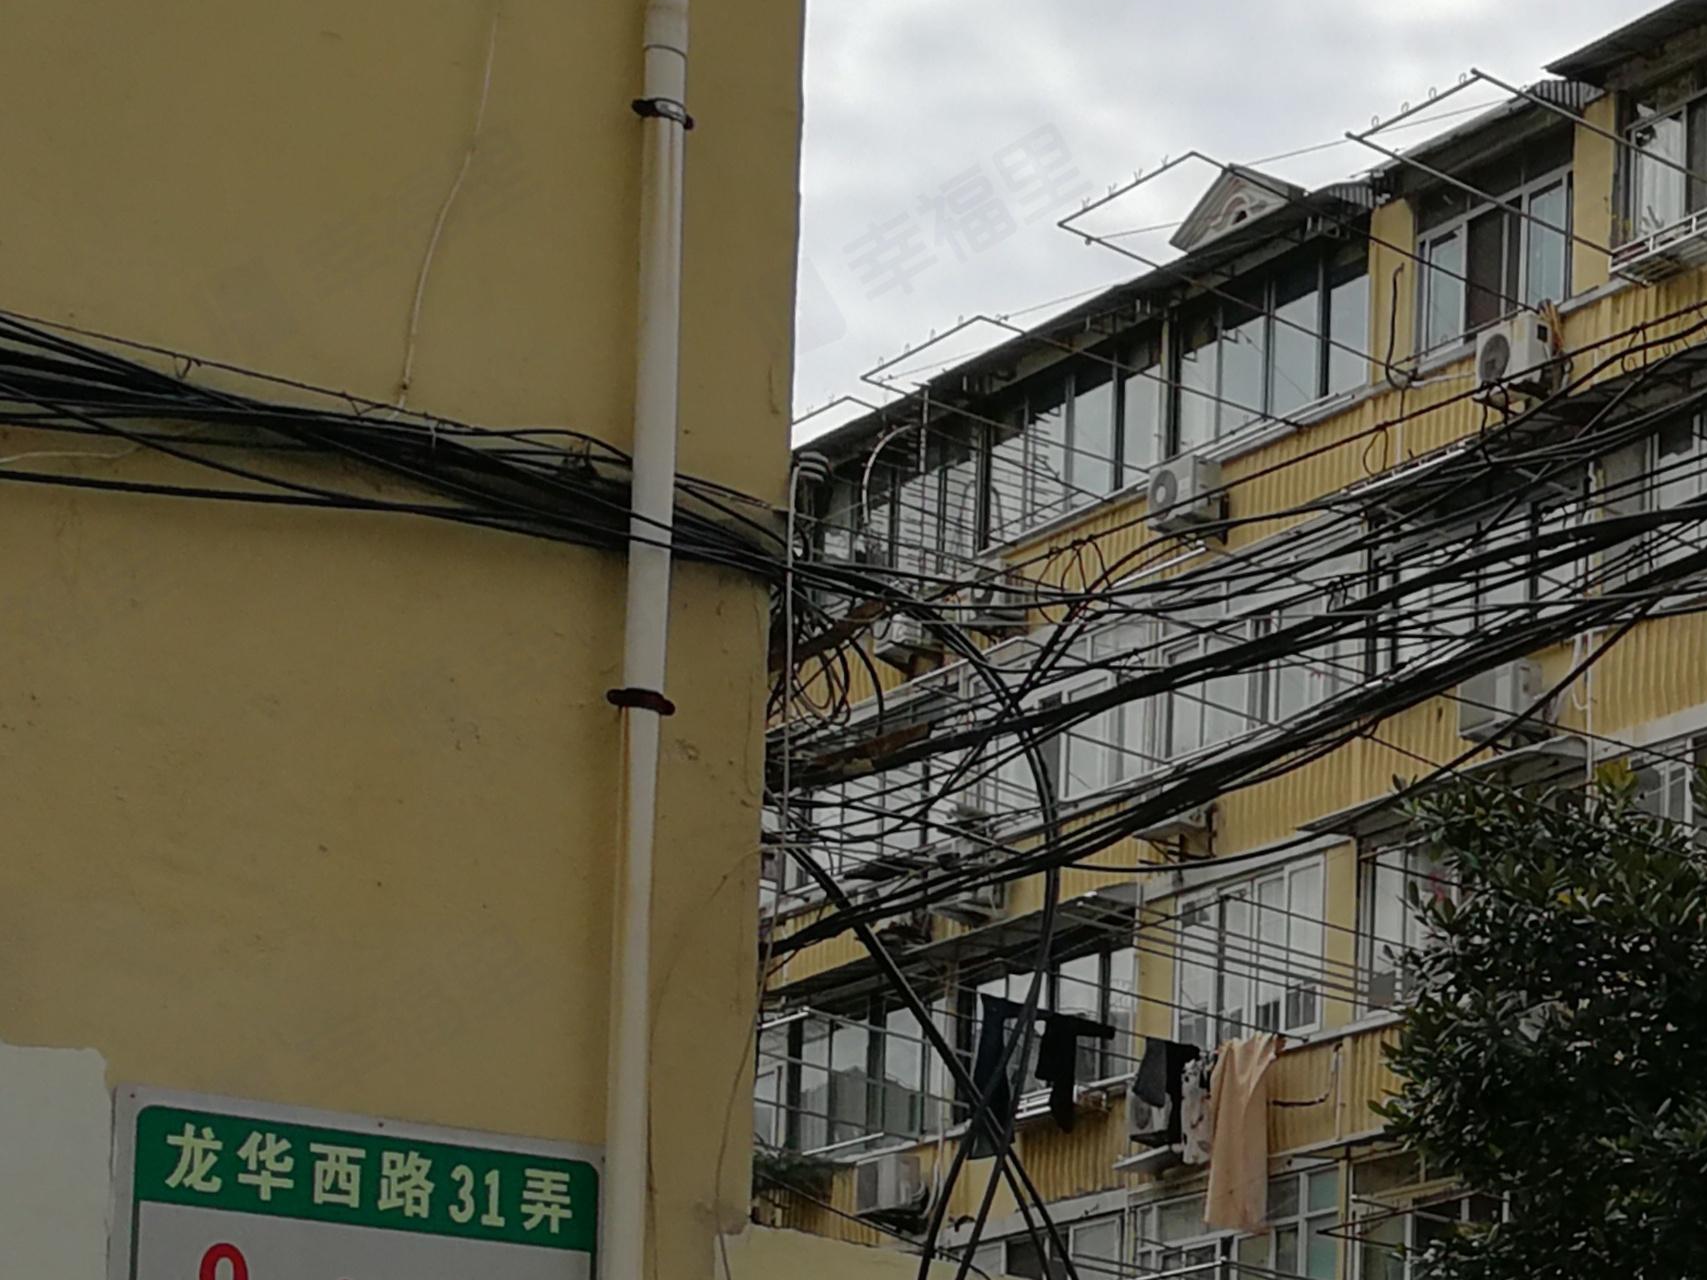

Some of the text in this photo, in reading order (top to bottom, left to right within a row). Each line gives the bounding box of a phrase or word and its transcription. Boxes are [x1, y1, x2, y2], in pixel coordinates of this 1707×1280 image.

[164, 1122, 574, 1234] 龙华西路31弄
